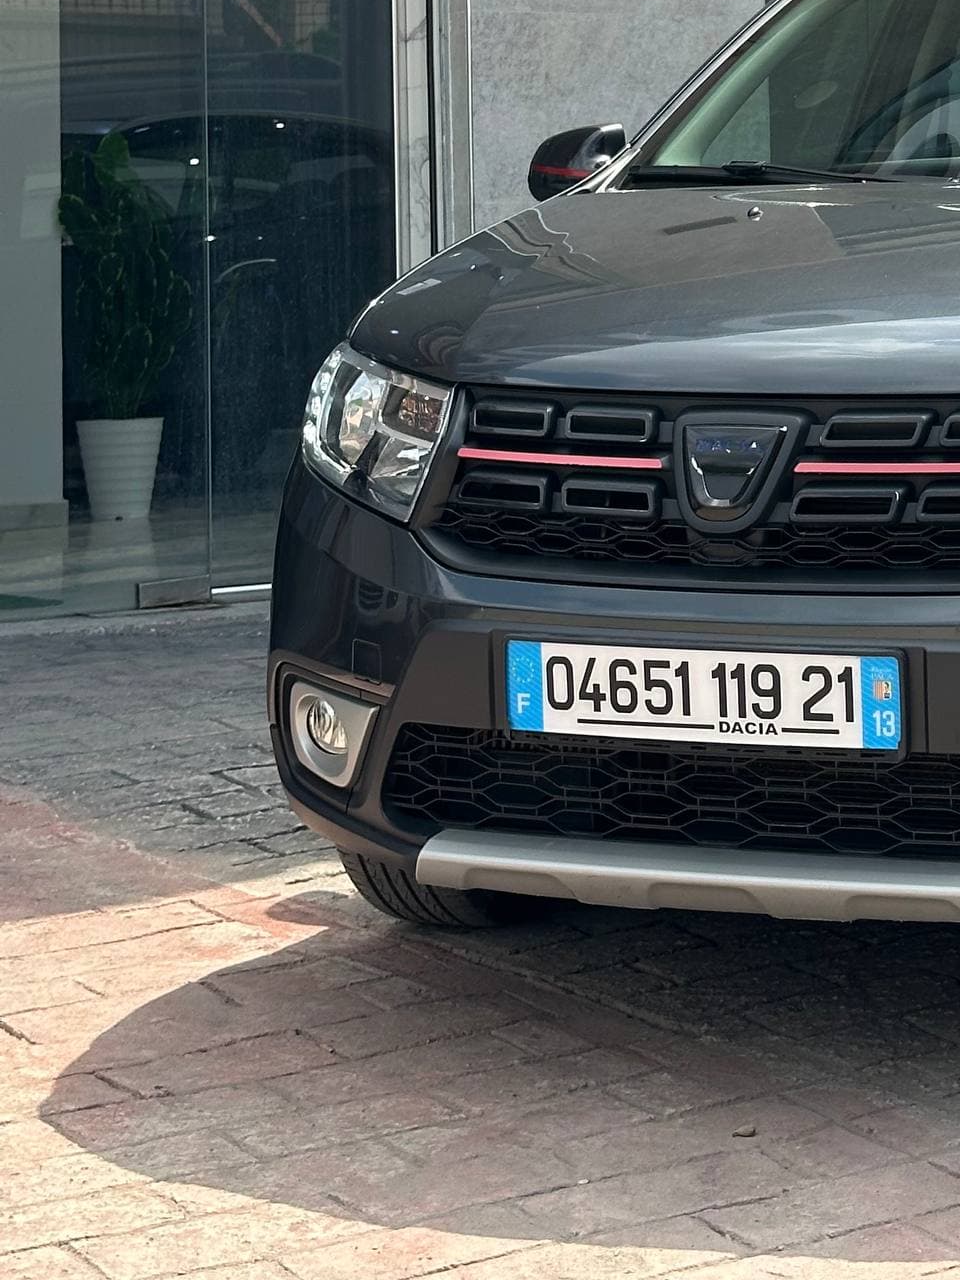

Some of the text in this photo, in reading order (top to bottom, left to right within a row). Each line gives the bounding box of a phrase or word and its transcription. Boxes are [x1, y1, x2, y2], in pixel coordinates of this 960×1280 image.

[545, 655, 855, 723] 04651 119 21
[517, 692, 531, 714] F
[718, 721, 779, 736] DACIA
[872, 710, 896, 737] 13
